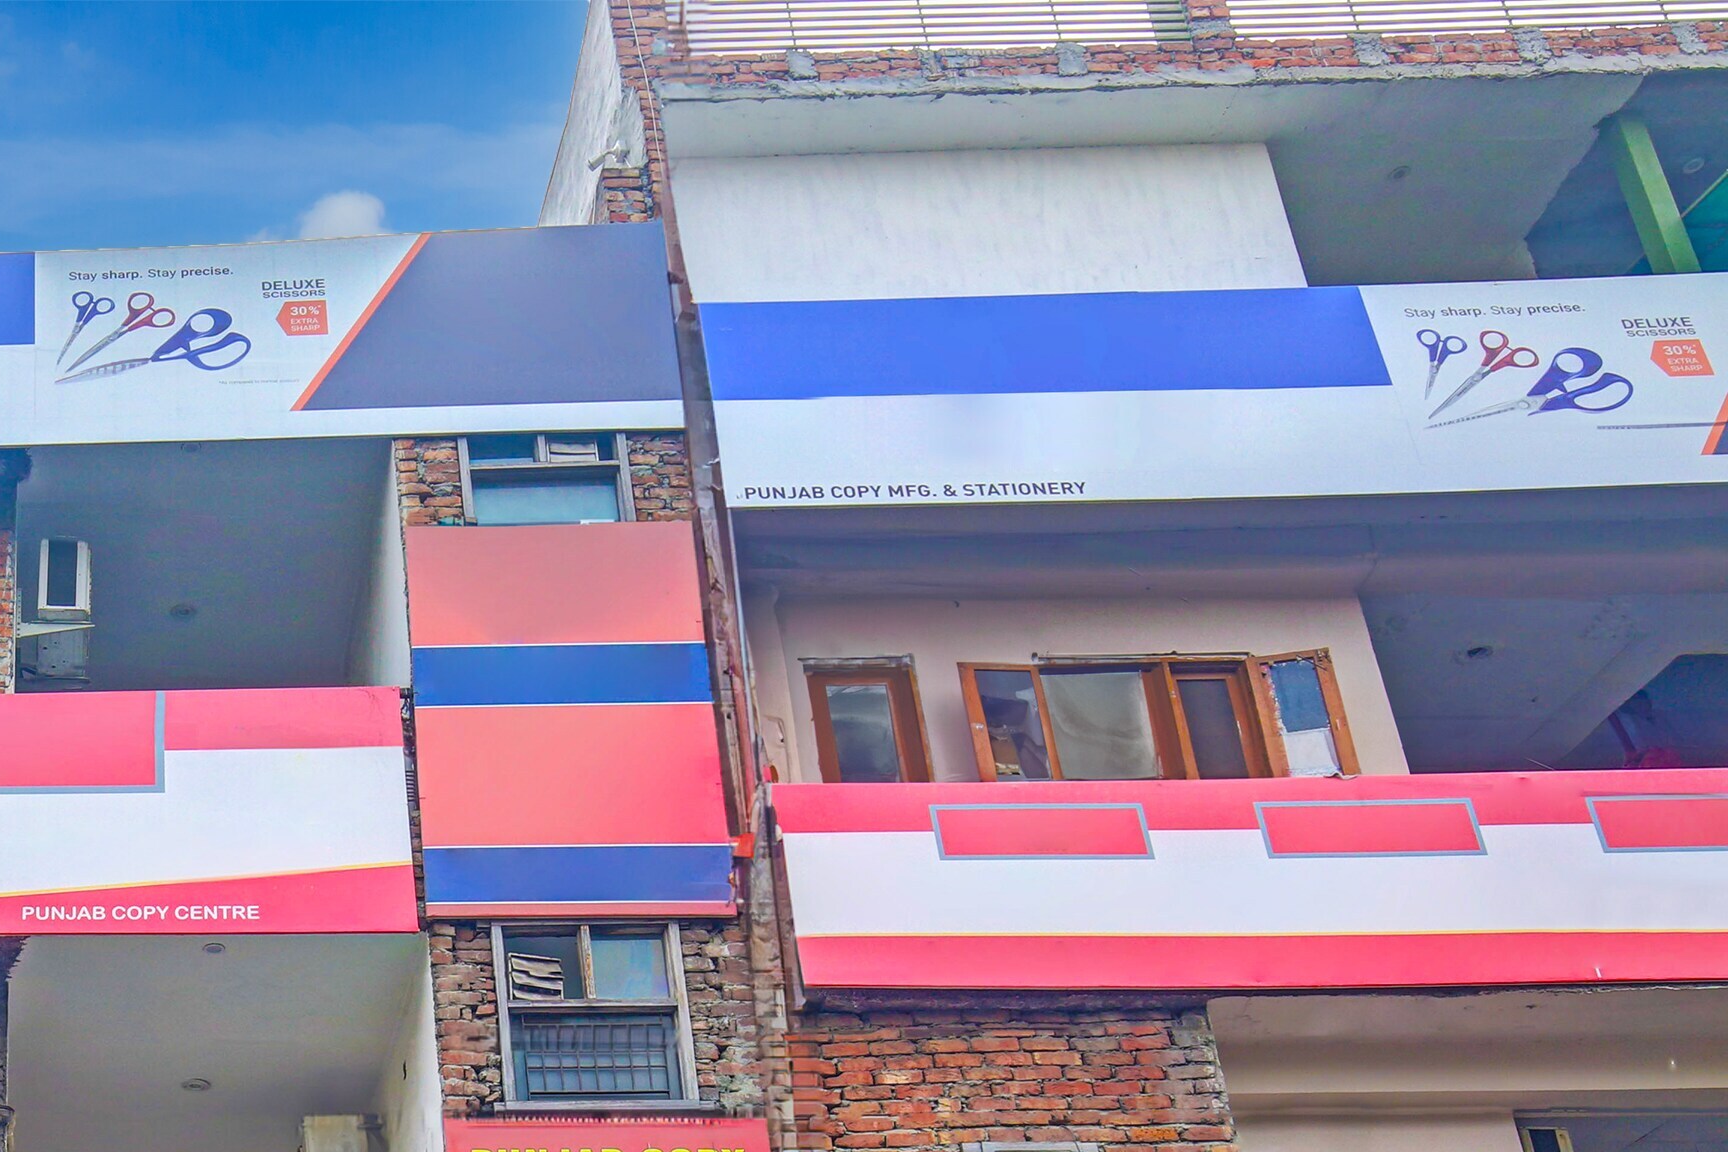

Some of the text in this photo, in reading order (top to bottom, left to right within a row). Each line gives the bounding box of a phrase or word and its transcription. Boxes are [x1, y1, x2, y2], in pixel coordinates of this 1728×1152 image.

[69, 266, 234, 282] Stay sharp. Stay precise.
[261, 278, 325, 292] DELUXE
[262, 289, 326, 299] SCISSORS
[1404, 302, 1586, 319] Stay sharp. Stay precise.
[290, 317, 319, 325] EXTRA
[1621, 316, 1693, 330] DELUXE
[290, 324, 320, 332] SHARP
[1625, 327, 1696, 337] SCISSORS
[1667, 357, 1699, 365] EXTRA
[1671, 364, 1703, 372] SHARP
[744, 481, 1086, 500] PUNJAB COPY MFG. & STATIONERY
[22, 905, 260, 920] PUNJAB COPY CENTRE
